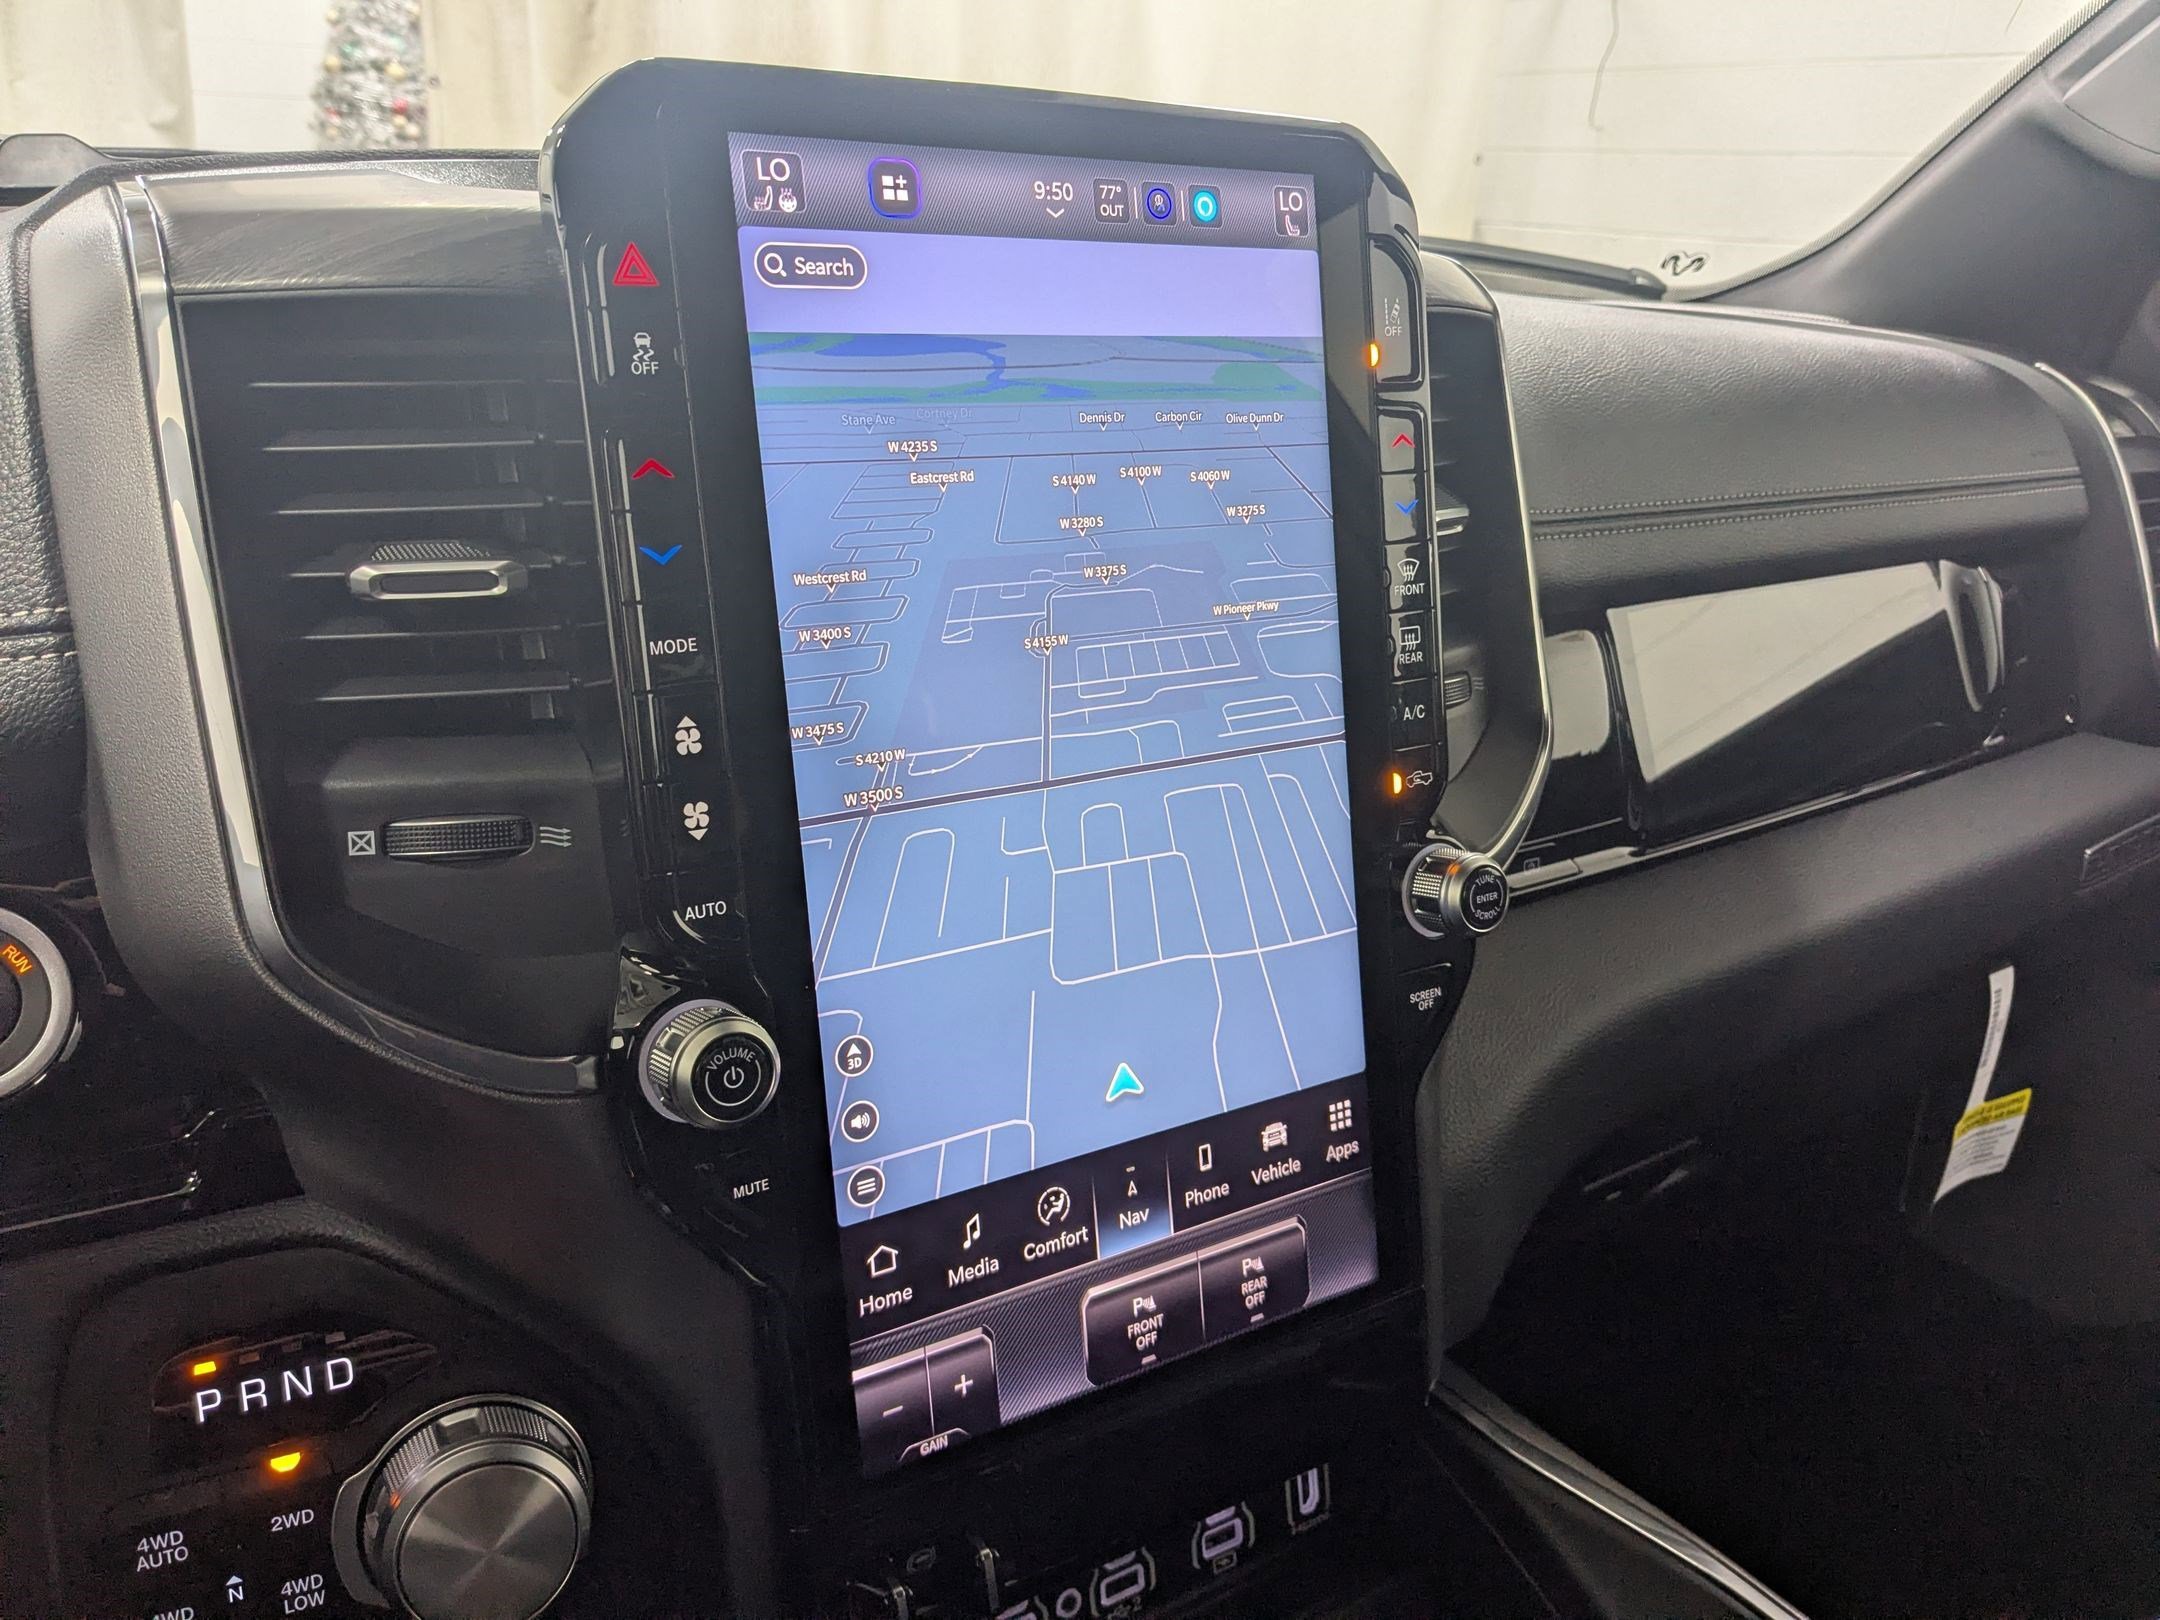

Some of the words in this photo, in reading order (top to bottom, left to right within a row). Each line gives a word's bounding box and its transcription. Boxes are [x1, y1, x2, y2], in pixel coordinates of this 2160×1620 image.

[756, 156, 790, 181] LO
[1034, 181, 1074, 201] 9:50
[1099, 185, 1121, 200] 77°
[1279, 191, 1303, 212] LO
[1100, 204, 1124, 217] OUT
[794, 256, 854, 277] Search
[1384, 326, 1402, 337] OFF
[631, 361, 659, 375] OFF
[841, 414, 873, 426] Stane
[875, 414, 896, 425] Ave
[1079, 412, 1112, 423] Dennis
[1114, 412, 1125, 422] Dr
[1155, 412, 1187, 423] Carbon
[1189, 411, 1202, 422] Cir
[1226, 413, 1248, 424] Olive
[1250, 412, 1273, 423] Dunn
[1274, 412, 1284, 422] Dr
[888, 442, 899, 453] W
[899, 441, 929, 453] 4235
[929, 441, 938, 452] S
[910, 472, 958, 485] Eastcrest
[960, 470, 975, 482] Rd
[1120, 467, 1127, 478] S
[1127, 466, 1151, 478] 4100
[1151, 465, 1162, 476] W
[1190, 471, 1197, 482] S
[1197, 471, 1220, 481] 4060
[1220, 470, 1230, 481] W
[1052, 476, 1059, 487] S
[1060, 474, 1086, 486] 4140
[1086, 474, 1096, 485] W
[1227, 506, 1238, 517] W
[1238, 505, 1259, 516] 3275
[1259, 504, 1266, 515] S
[1060, 518, 1071, 529] W
[1072, 517, 1096, 528] 3280
[1096, 516, 1104, 527] S
[793, 571, 850, 586] Westcrest
[851, 569, 867, 581] Rd
[1083, 566, 1095, 578] W
[1095, 565, 1119, 577] 3375
[1119, 564, 1127, 575] S
[1394, 583, 1425, 596] FRONT
[1213, 605, 1223, 616] W
[1223, 603, 1255, 615] Pioneer
[1257, 601, 1279, 614] Pkwy
[799, 631, 811, 642] W
[813, 627, 842, 641] 3400
[843, 626, 851, 638] S
[1024, 638, 1031, 650] S
[1032, 635, 1058, 648] 4155
[1058, 634, 1069, 645] W
[649, 637, 698, 656] MODE
[1399, 651, 1423, 664] REAR
[1403, 704, 1425, 721] A/C
[792, 727, 804, 739] W
[805, 723, 835, 738] 3475
[836, 722, 844, 733] S
[855, 754, 864, 766] S
[864, 750, 893, 765] 4210
[893, 748, 906, 761] W
[843, 793, 858, 808] W
[860, 788, 893, 804] 3500
[894, 786, 904, 800] S
[1475, 873, 1496, 885] TUNE
[1476, 891, 1498, 904] ENTER
[685, 900, 727, 921] AUTO
[1474, 905, 1500, 921] SCROLL
[3, 944, 33, 974] RUN
[1409, 986, 1441, 1004] SCREEN
[1418, 998, 1435, 1011] OFF
[706, 1047, 756, 1072] VOLUME
[847, 1057, 862, 1070] 3D
[1326, 1138, 1360, 1163] Apps
[1251, 1157, 1302, 1186] Vehicle
[733, 1178, 770, 1200] MUTE
[1185, 1182, 1230, 1208] Phone
[1119, 1207, 1150, 1230] Nav
[1023, 1226, 1089, 1262] Comfort
[948, 1256, 1000, 1288] Media
[1241, 1275, 1268, 1296] REAR
[859, 1286, 913, 1318] Home
[1245, 1290, 1266, 1309] OFF
[1127, 1313, 1163, 1339] FRONT
[1135, 1330, 1158, 1351] OFF
[196, 1388, 222, 1423] P
[240, 1378, 267, 1412] R
[282, 1365, 313, 1401] N
[326, 1357, 354, 1391] D
[919, 1435, 949, 1456] GAIN
[270, 1509, 315, 1532] 2WD
[137, 1530, 184, 1553] 4WD
[136, 1547, 189, 1572] AUTO
[280, 1573, 324, 1597] 4WD
[228, 1586, 244, 1603] N
[283, 1590, 326, 1615] LOW
